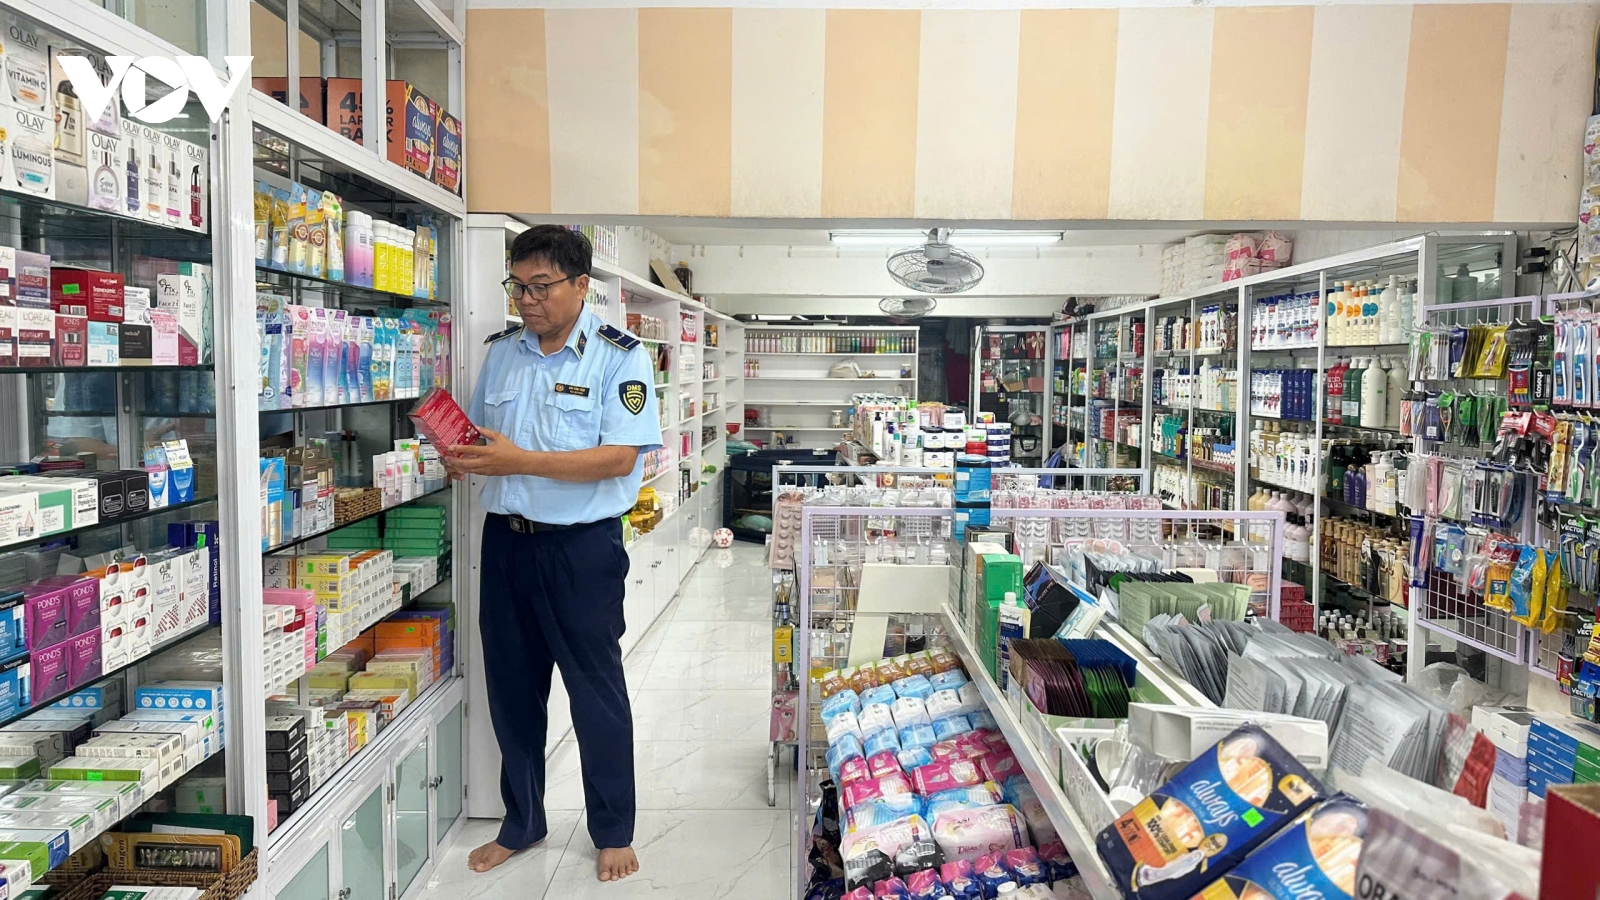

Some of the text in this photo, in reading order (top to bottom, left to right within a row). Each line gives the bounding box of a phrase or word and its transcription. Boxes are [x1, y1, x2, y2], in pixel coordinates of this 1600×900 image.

[10, 25, 39, 48] OLAY
[8, 68, 46, 90] VITAMIN C
[16, 111, 45, 131] OLAY
[62, 110, 70, 130] 7
[122, 119, 141, 134] OLAY
[412, 113, 431, 140] always
[92, 133, 118, 152] OLAY
[144, 127, 161, 142] OLAY
[164, 135, 181, 148] OLAY
[12, 150, 51, 167] LUMINOUS
[187, 144, 204, 159] OLAY
[1535, 371, 1543, 398] closeup
[73, 584, 94, 597] POND'S
[38, 596, 60, 610] POND'S
[75, 635, 95, 649] POND'S
[39, 648, 61, 663] POND'S
[1190, 780, 1238, 827] always
